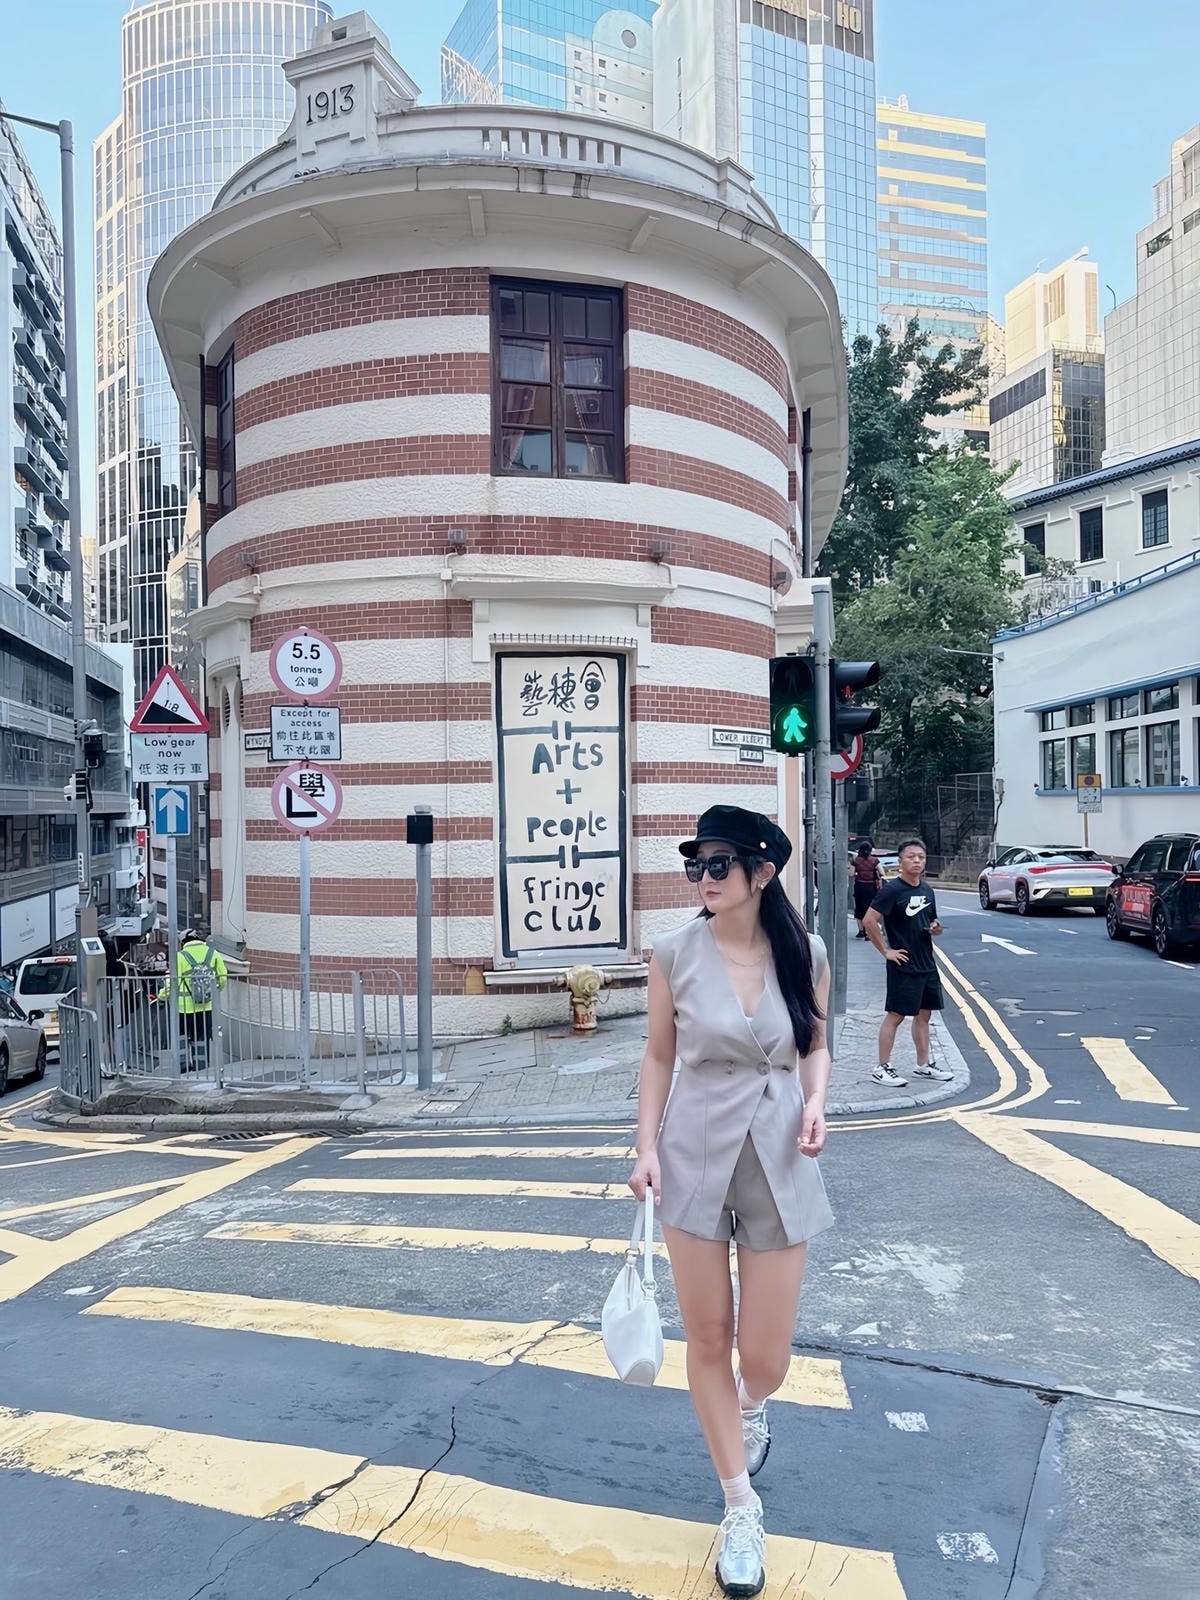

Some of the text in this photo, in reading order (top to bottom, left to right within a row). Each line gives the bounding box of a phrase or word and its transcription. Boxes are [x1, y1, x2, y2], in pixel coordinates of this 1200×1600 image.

[306, 83, 354, 124] 1913
[292, 643, 321, 660] 5.5
[290, 665, 323, 674] tonnes
[164, 700, 180, 713] 1:8
[280, 709, 331, 719] Except for
[144, 738, 196, 748] Low gear
[158, 750, 182, 758] now
[532, 742, 604, 774] Arts
[139, 763, 202, 775] 低波行車
[299, 773, 325, 798] 學
[286, 786, 318, 818] L
